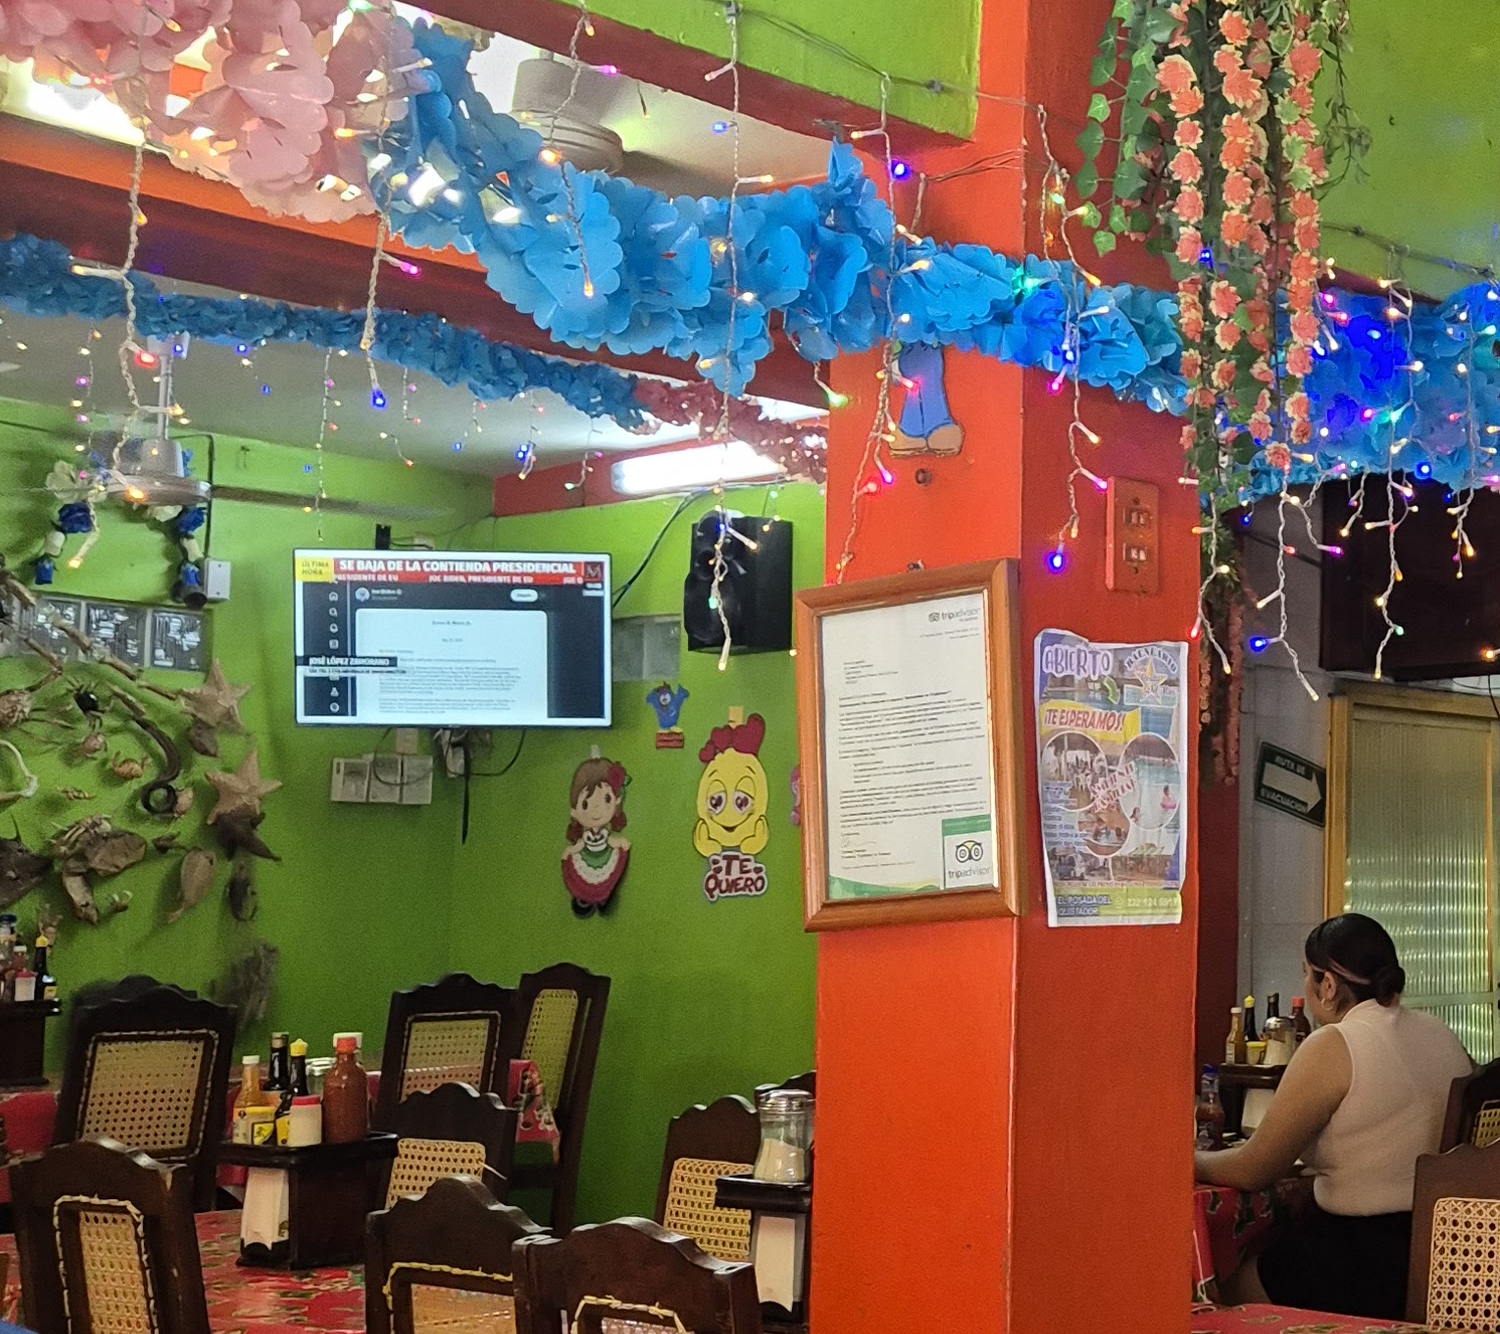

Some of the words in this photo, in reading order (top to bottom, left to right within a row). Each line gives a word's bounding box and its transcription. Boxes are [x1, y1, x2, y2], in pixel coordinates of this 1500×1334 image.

[339, 560, 355, 571] SE
[356, 560, 385, 572] BAJA
[387, 560, 404, 571] DE
[405, 561, 422, 572] LA
[422, 561, 491, 572] CONTIENDA
[492, 562, 576, 573] PRESIDENCIAL
[722, 855, 752, 876] TE
[704, 874, 765, 899] QUIERO
